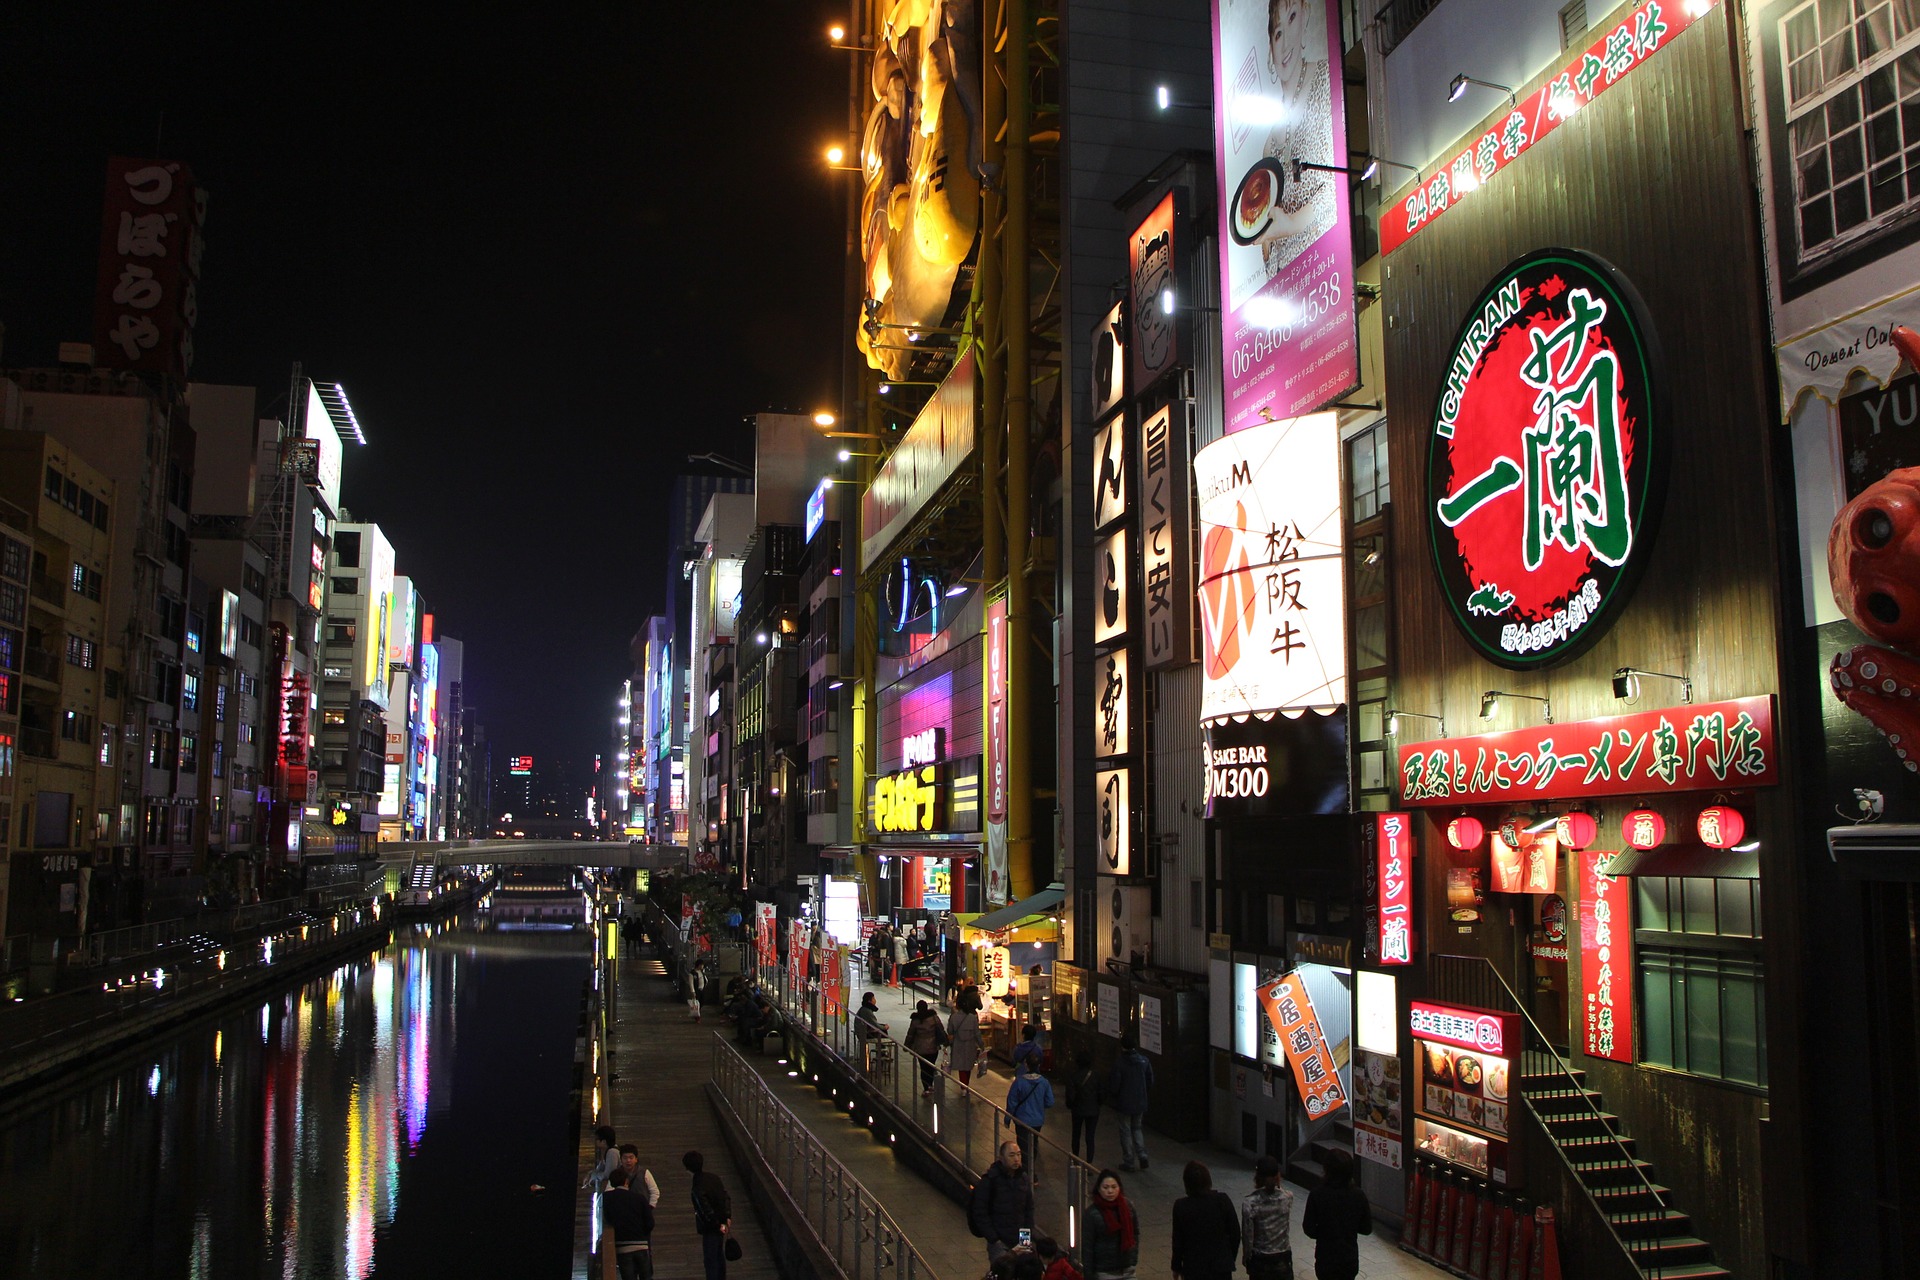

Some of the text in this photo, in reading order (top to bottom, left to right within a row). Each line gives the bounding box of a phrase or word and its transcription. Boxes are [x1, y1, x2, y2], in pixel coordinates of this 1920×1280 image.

[109, 163, 180, 361] づぼらや
[1436, 277, 1520, 439] ICHIRAN
[1805, 338, 1861, 372] Dessert
[1437, 287, 1634, 571] 一蘭
[1147, 416, 1173, 659] 旨くて安い
[1264, 519, 1309, 666] 松阪牛
[1500, 577, 1602, 654] 昭和35年創業
[991, 617, 1003, 810] Tax Free
[1213, 745, 1267, 766] SAKE BAR
[1213, 766, 1269, 798] M300
[1403, 710, 1767, 800] 天然とんこつラーメン専門店
[1632, 813, 1656, 848] 一蘭
[1698, 808, 1724, 845] 一蘭
[1277, 998, 1327, 1084] 居酒屋
[1411, 1008, 1475, 1043] お土産販売所
[1366, 1133, 1389, 1158] 桃福
